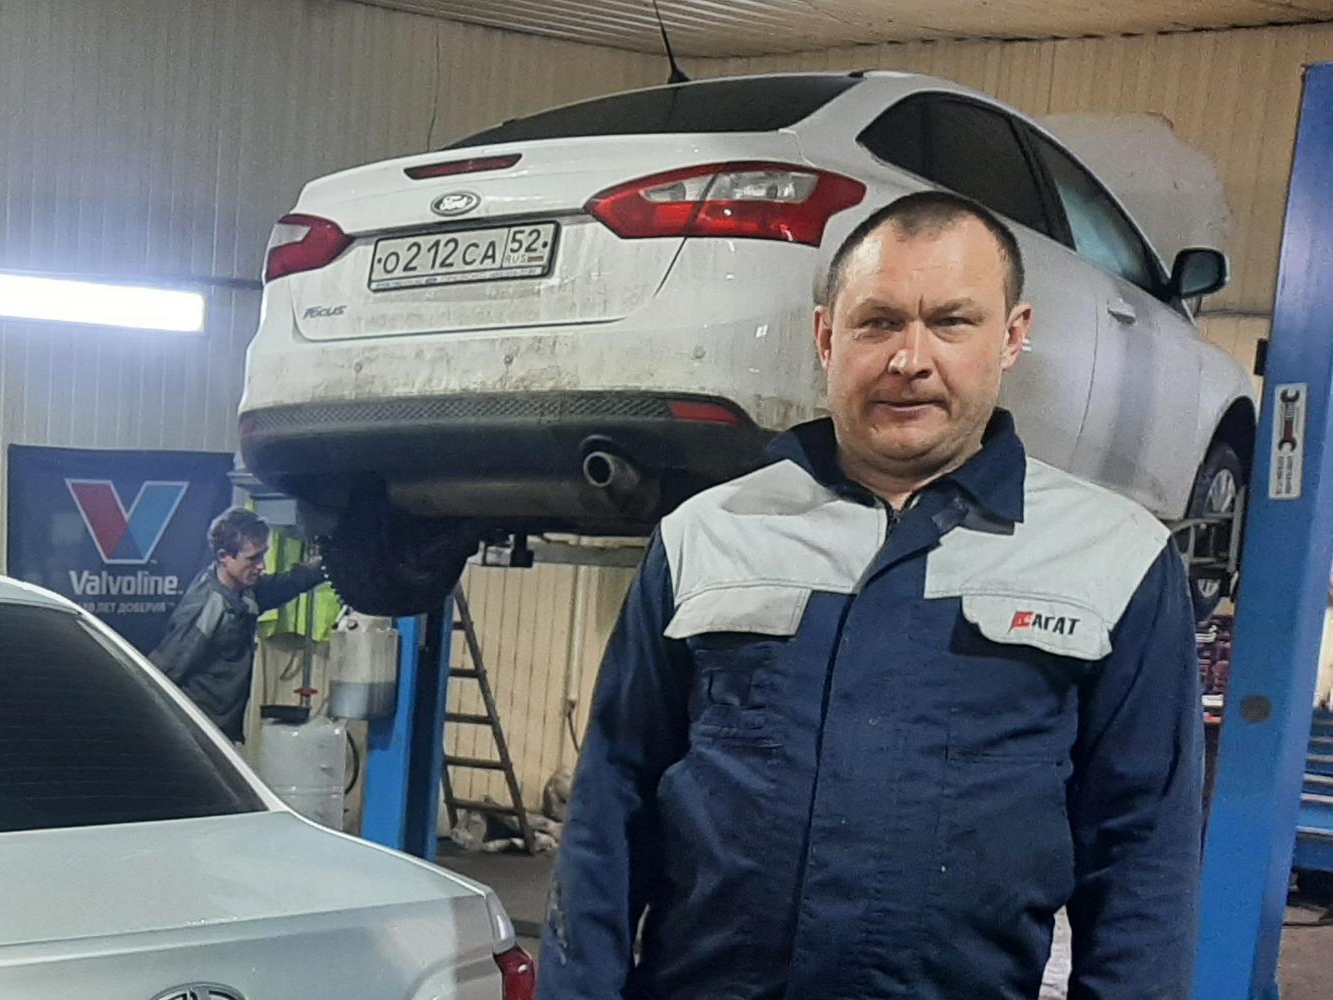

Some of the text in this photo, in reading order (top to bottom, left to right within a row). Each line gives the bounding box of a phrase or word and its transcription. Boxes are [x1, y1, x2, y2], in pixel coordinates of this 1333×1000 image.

[383, 229, 541, 274] О212СА 52
[69, 570, 179, 596] Valvoline
[1032, 613, 1081, 636] АГАТ
